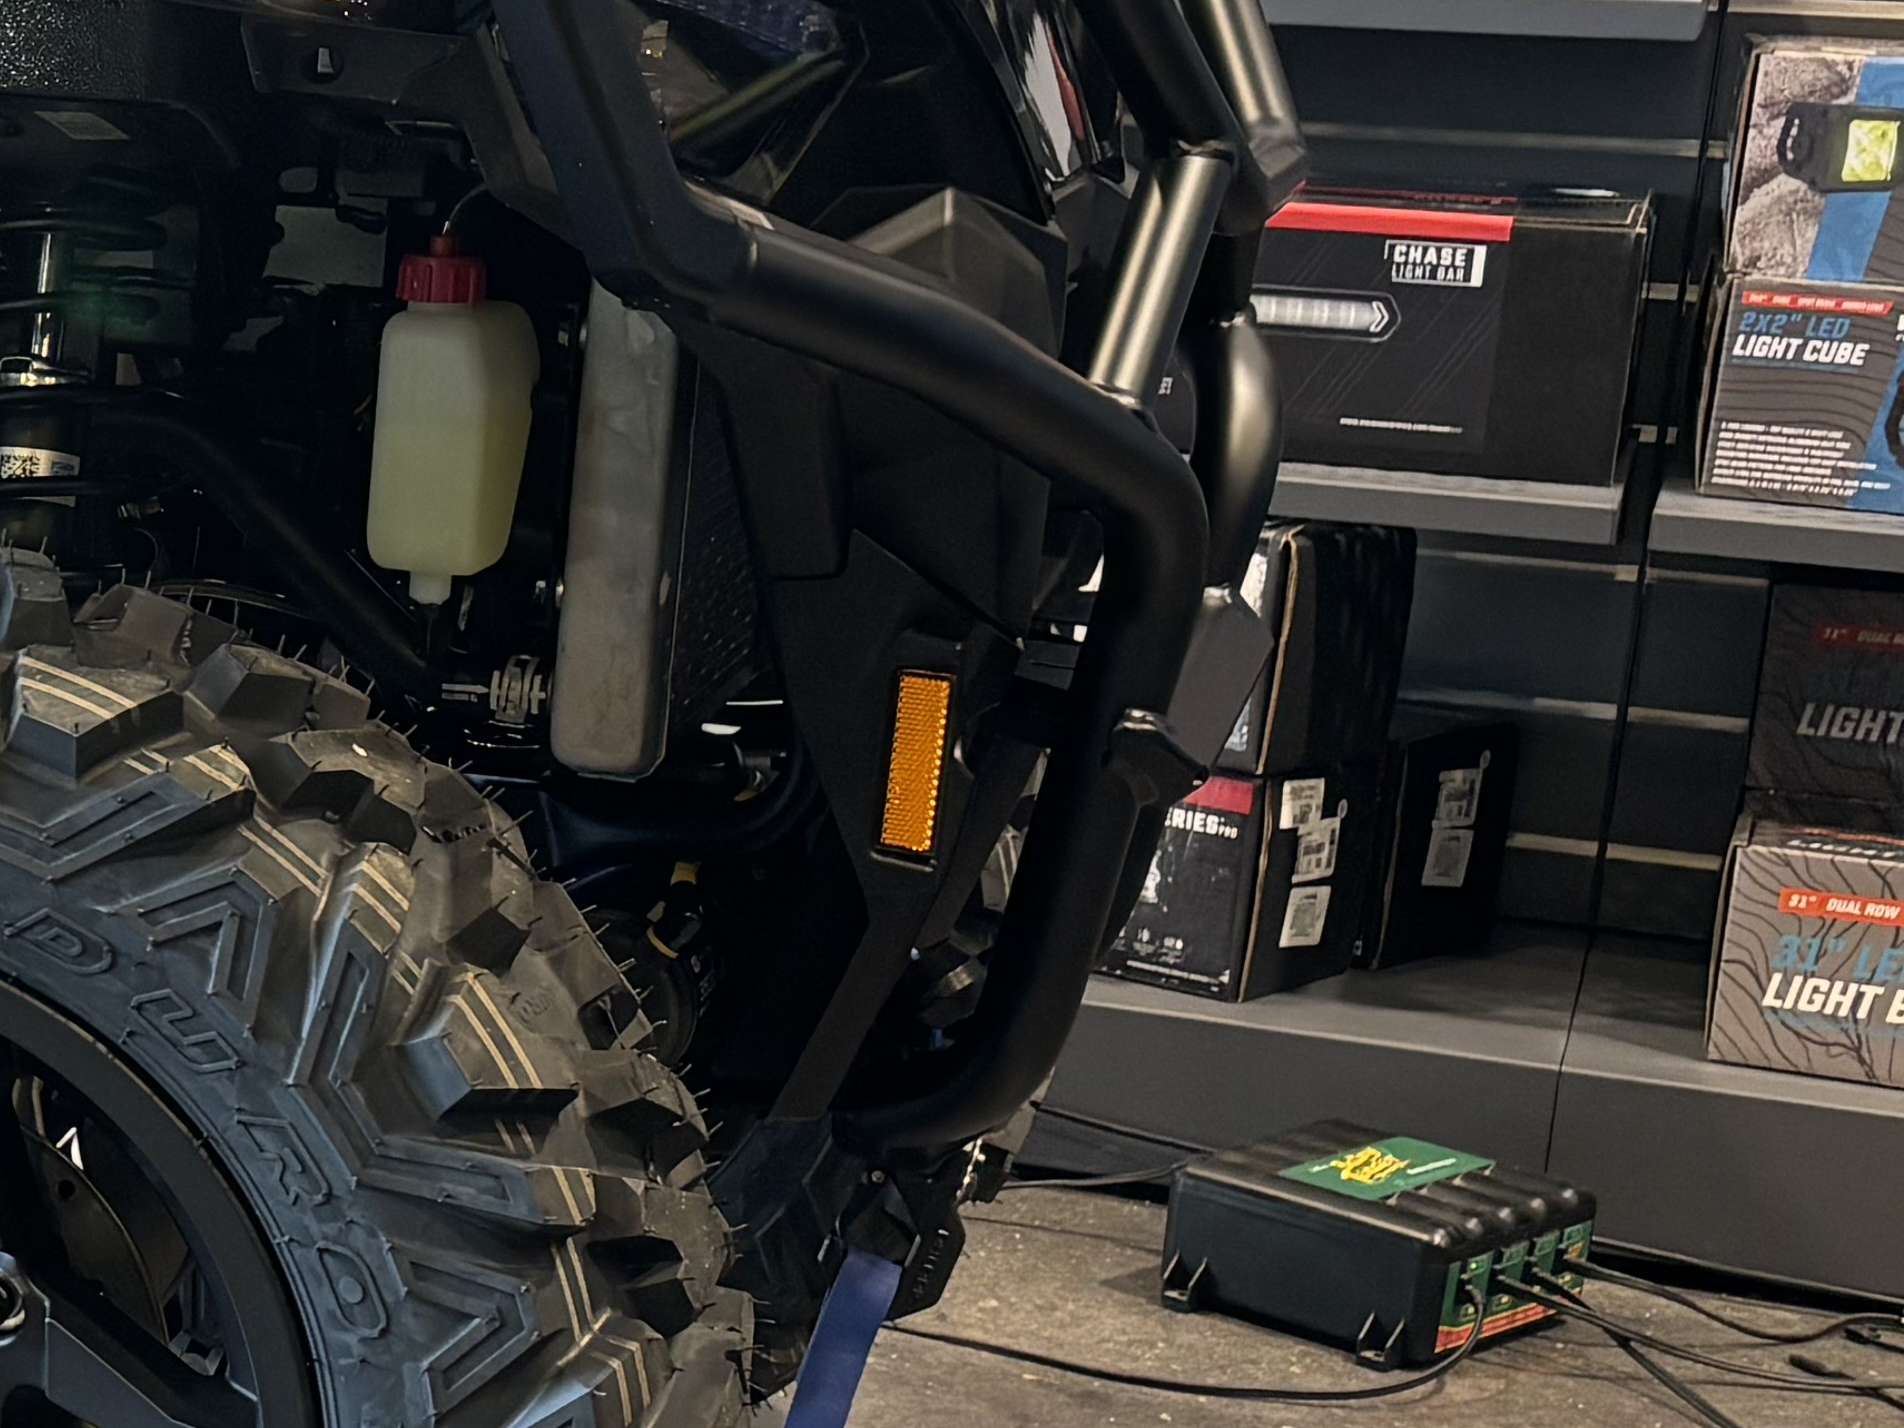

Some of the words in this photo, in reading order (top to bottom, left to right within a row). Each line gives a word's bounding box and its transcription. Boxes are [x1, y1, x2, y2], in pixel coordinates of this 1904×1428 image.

[1393, 243, 1468, 267] CHASE
[1391, 263, 1431, 281] LIGHT
[1436, 266, 1464, 283] BAR
[1738, 311, 1802, 336] 2X2"
[1804, 315, 1852, 339] LED
[1732, 334, 1803, 360] LIGHT
[1803, 340, 1871, 366] CUBE
[1795, 702, 1904, 745] LIGHT
[1825, 897, 1863, 916] DUAL
[1863, 901, 1902, 920] ROW
[1771, 933, 1850, 974] 31"
[1853, 943, 1904, 984] LE
[1762, 972, 1885, 1020] LIGHT
